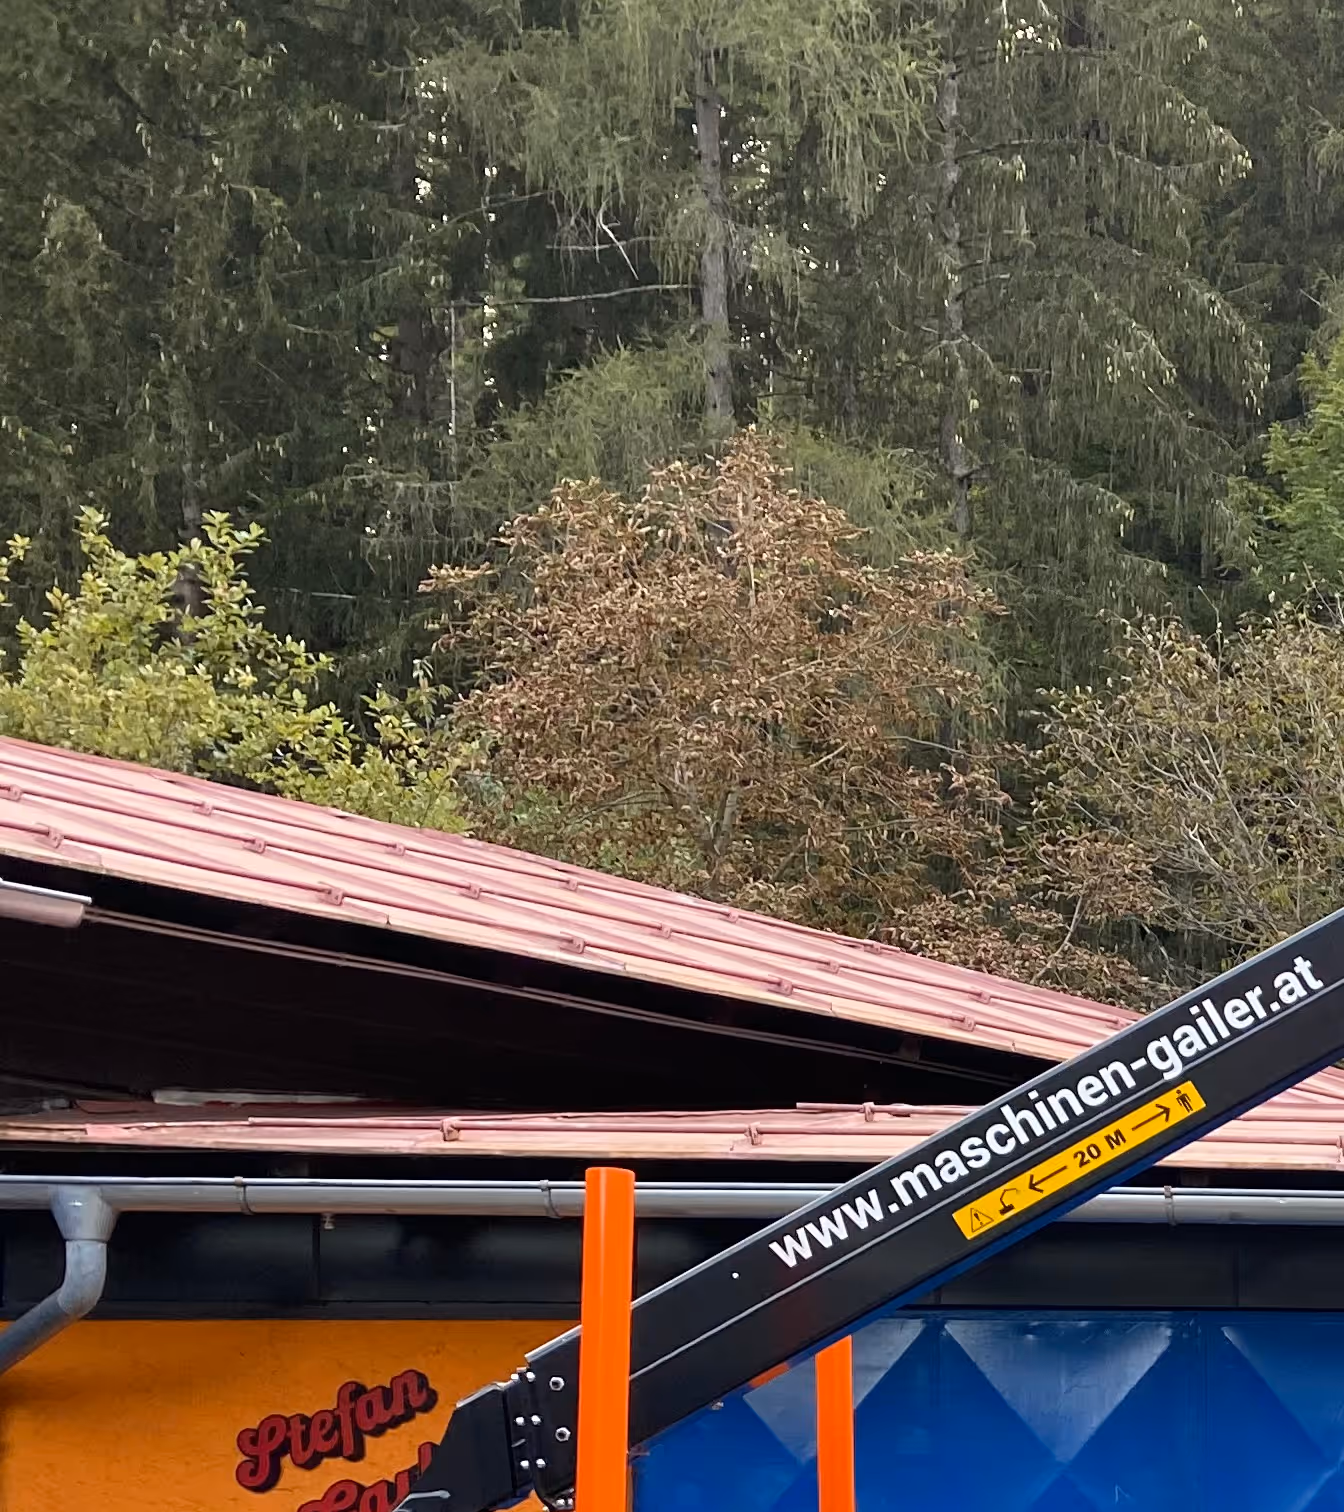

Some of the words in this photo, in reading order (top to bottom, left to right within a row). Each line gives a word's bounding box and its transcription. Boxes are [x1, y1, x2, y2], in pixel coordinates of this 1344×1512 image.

[768, 955, 1324, 1268] www.maschinen-gailer.at
[1073, 1143, 1102, 1169] 20
[1104, 1128, 1127, 1151] M
[236, 1369, 438, 1493] Stefan
